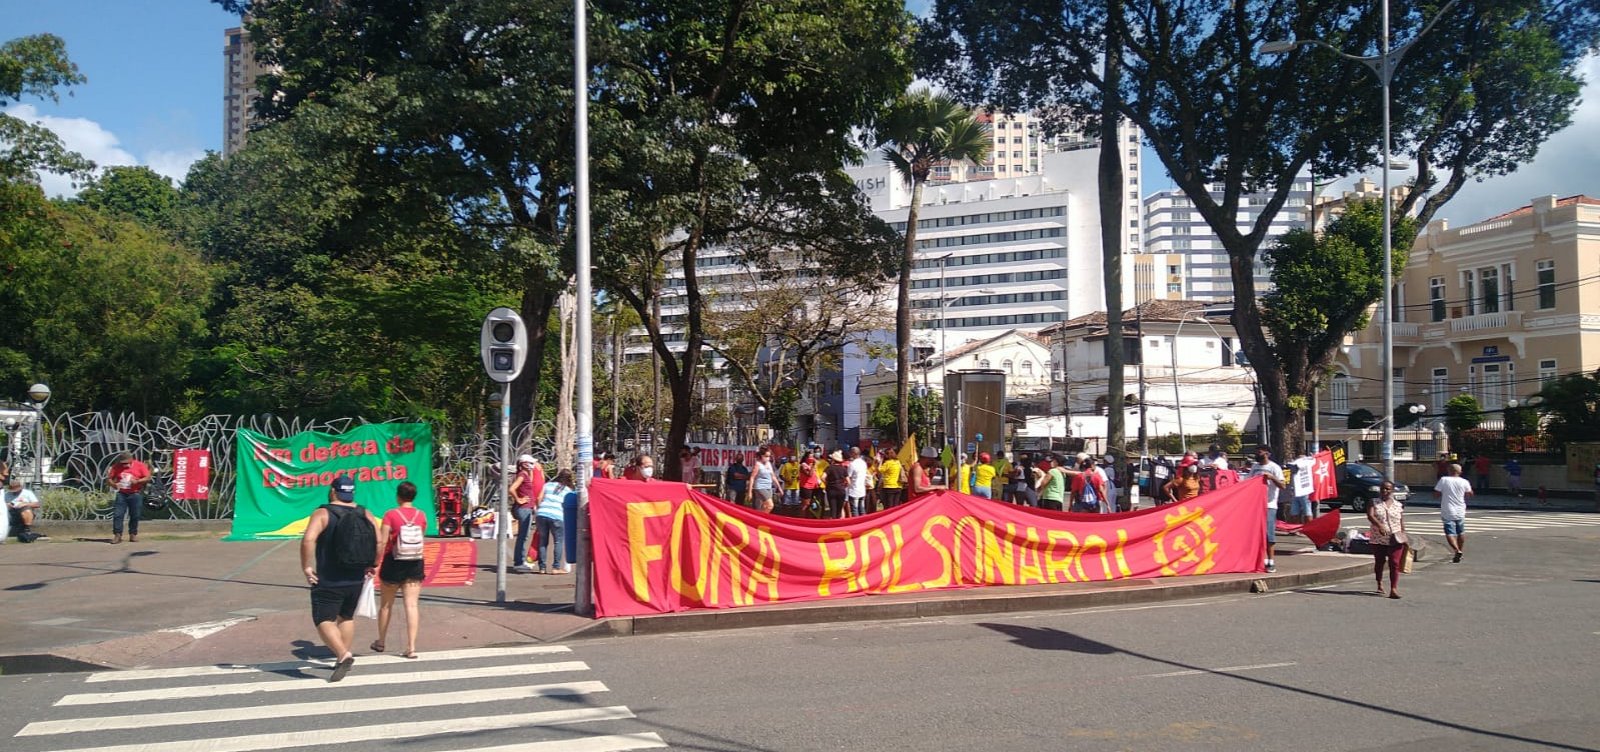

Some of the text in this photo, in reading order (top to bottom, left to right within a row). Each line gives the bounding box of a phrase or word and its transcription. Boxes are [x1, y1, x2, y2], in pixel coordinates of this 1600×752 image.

[254, 435, 416, 464] Em defesa da
[701, 448, 720, 467] TAS
[175, 456, 189, 494] SOCIALISMO
[262, 461, 408, 489] Democracia
[626, 499, 781, 606] FORA
